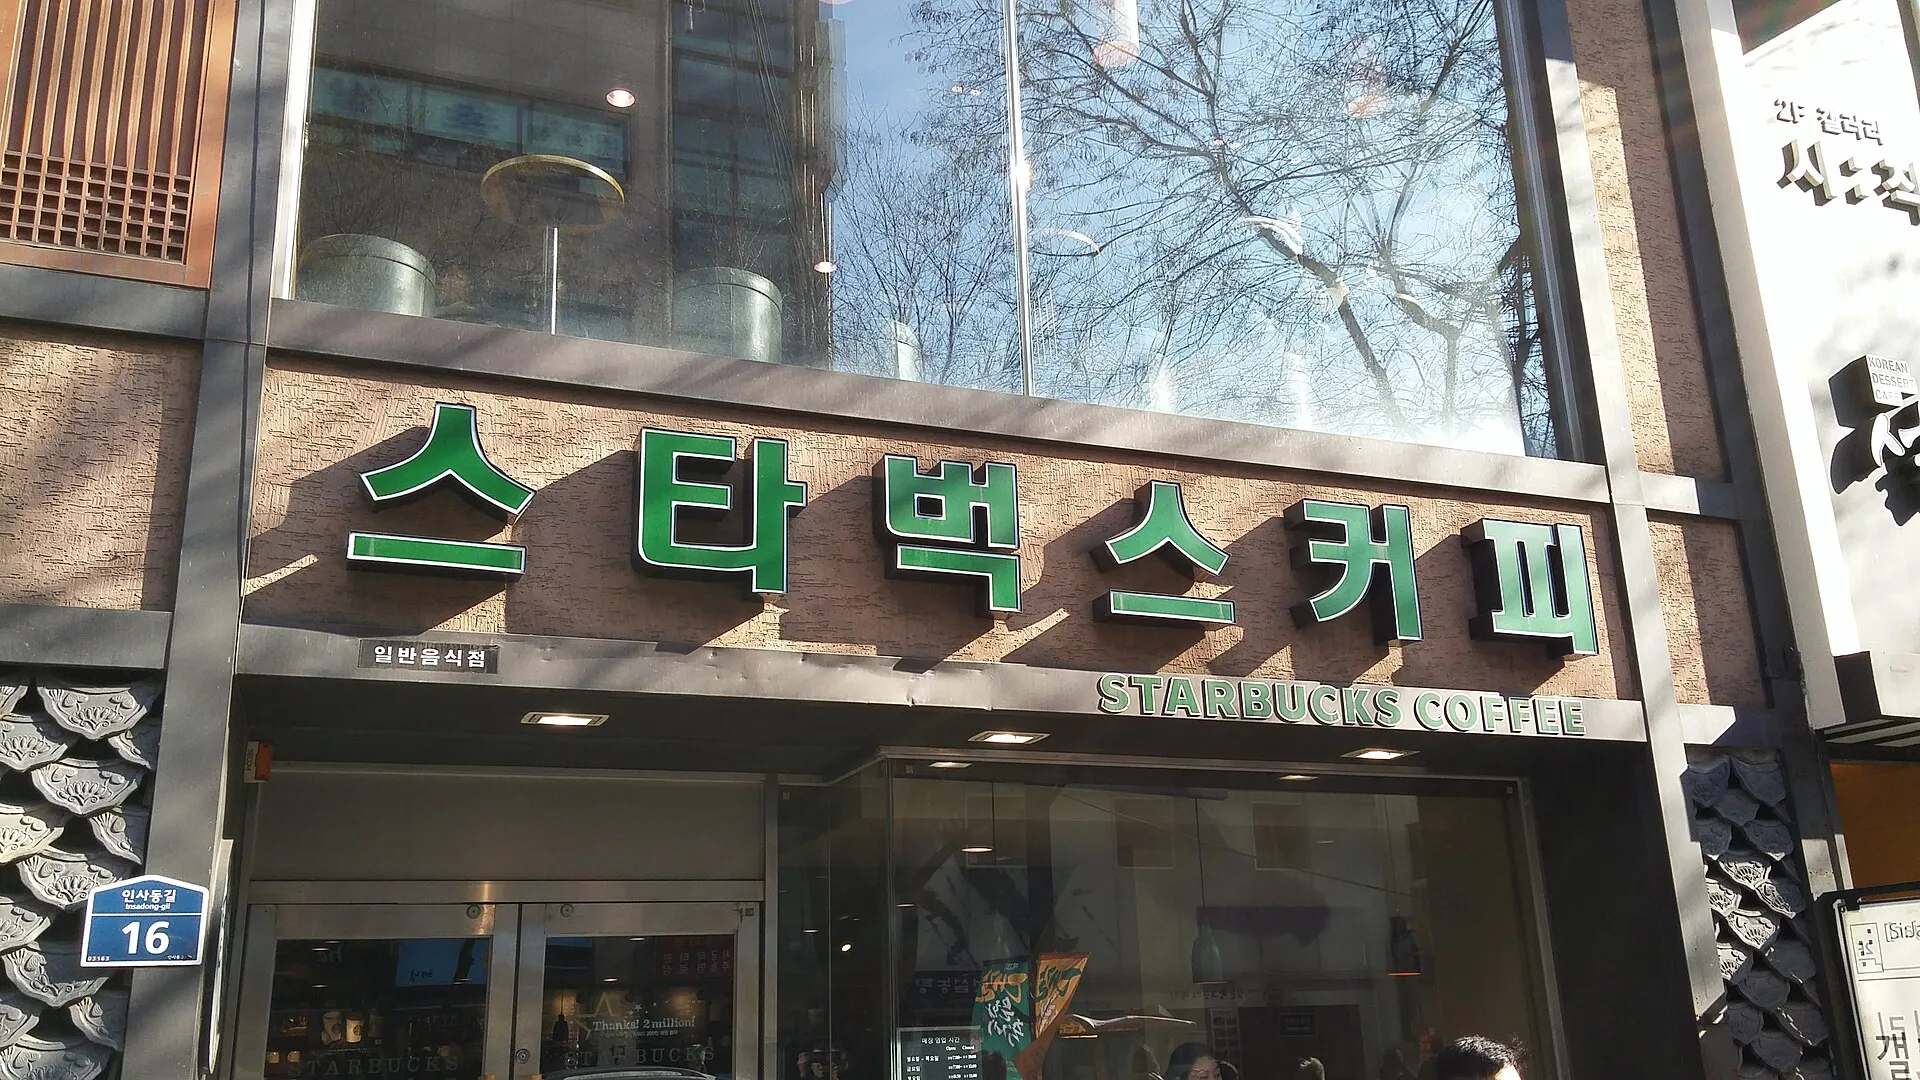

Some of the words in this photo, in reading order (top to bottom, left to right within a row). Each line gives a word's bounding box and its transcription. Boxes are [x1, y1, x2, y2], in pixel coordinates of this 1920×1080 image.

[1868, 356, 1909, 374] KOREAN
[1872, 372, 1915, 389] DESSERT
[374, 645, 486, 668] 일반음식점
[1098, 672, 1404, 728] STARBUCKS
[1412, 691, 1587, 738] COFFEE
[121, 889, 177, 903] 인사동길
[125, 903, 172, 911] Insadong-gil
[121, 920, 170, 955] 16
[592, 1018, 640, 1031] Thanks!
[288, 1054, 459, 1077] STARBUCKS
